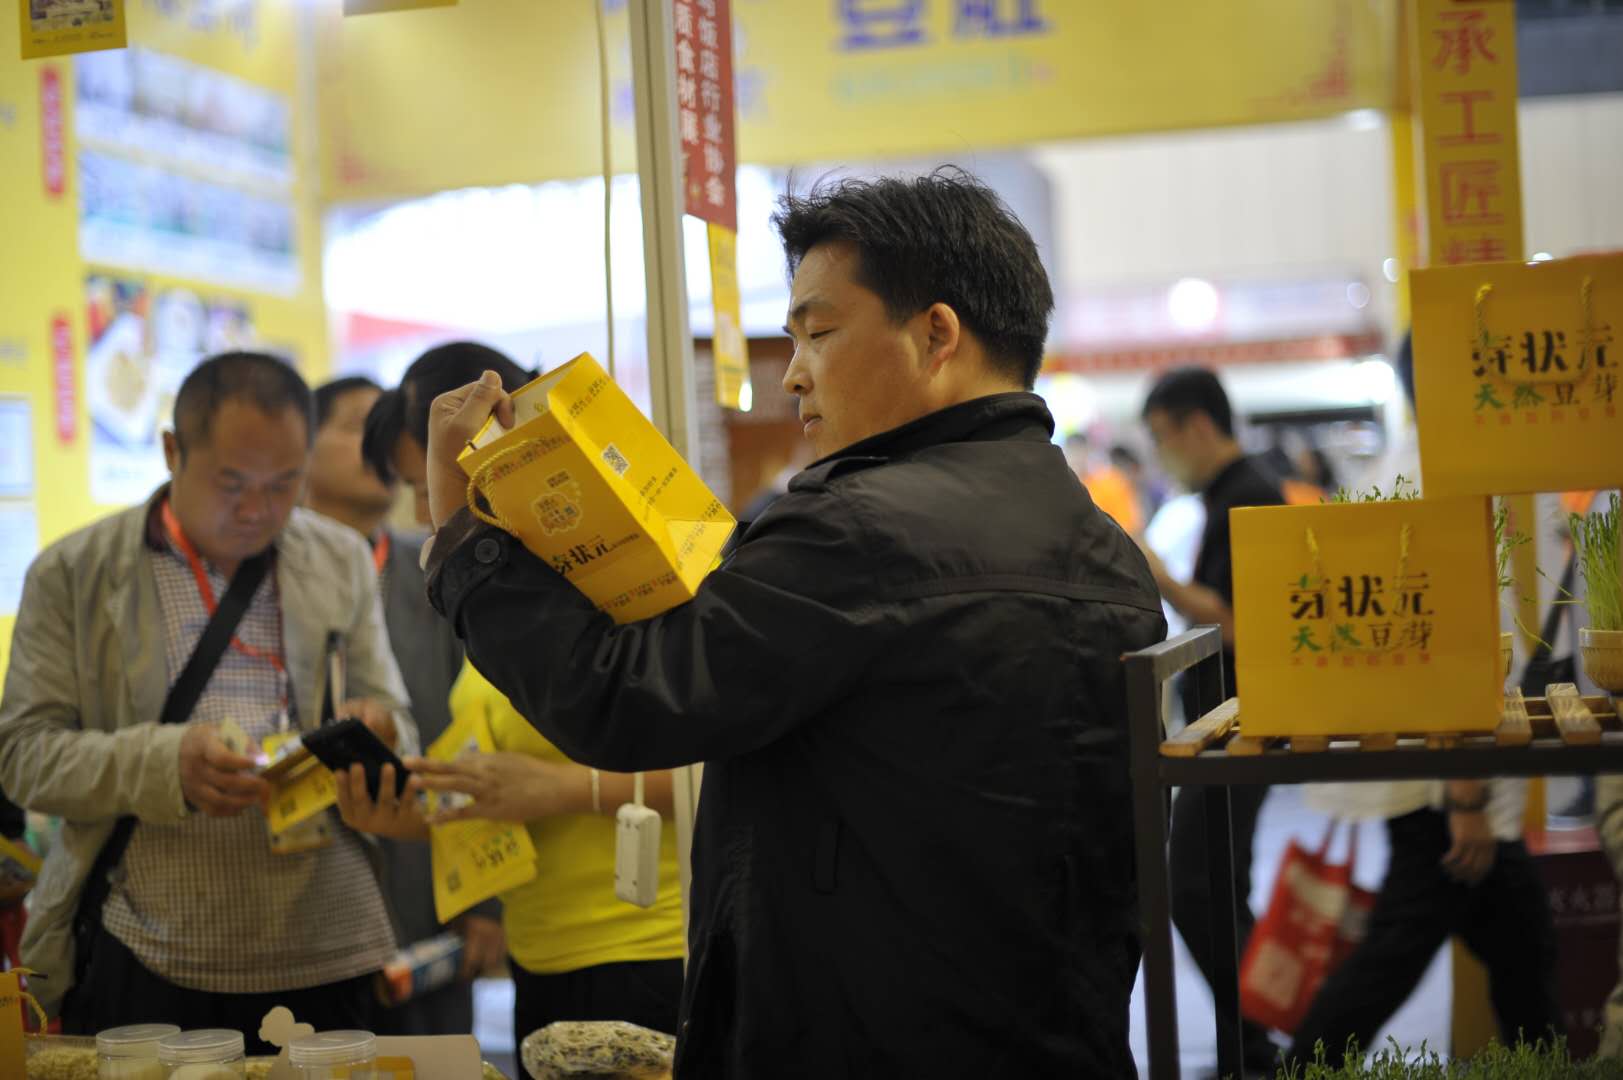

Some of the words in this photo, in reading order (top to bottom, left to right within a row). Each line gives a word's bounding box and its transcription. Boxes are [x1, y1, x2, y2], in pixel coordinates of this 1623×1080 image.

[1288, 571, 1435, 619] 芽状元
[1291, 620, 1434, 654] 天然豆芽
